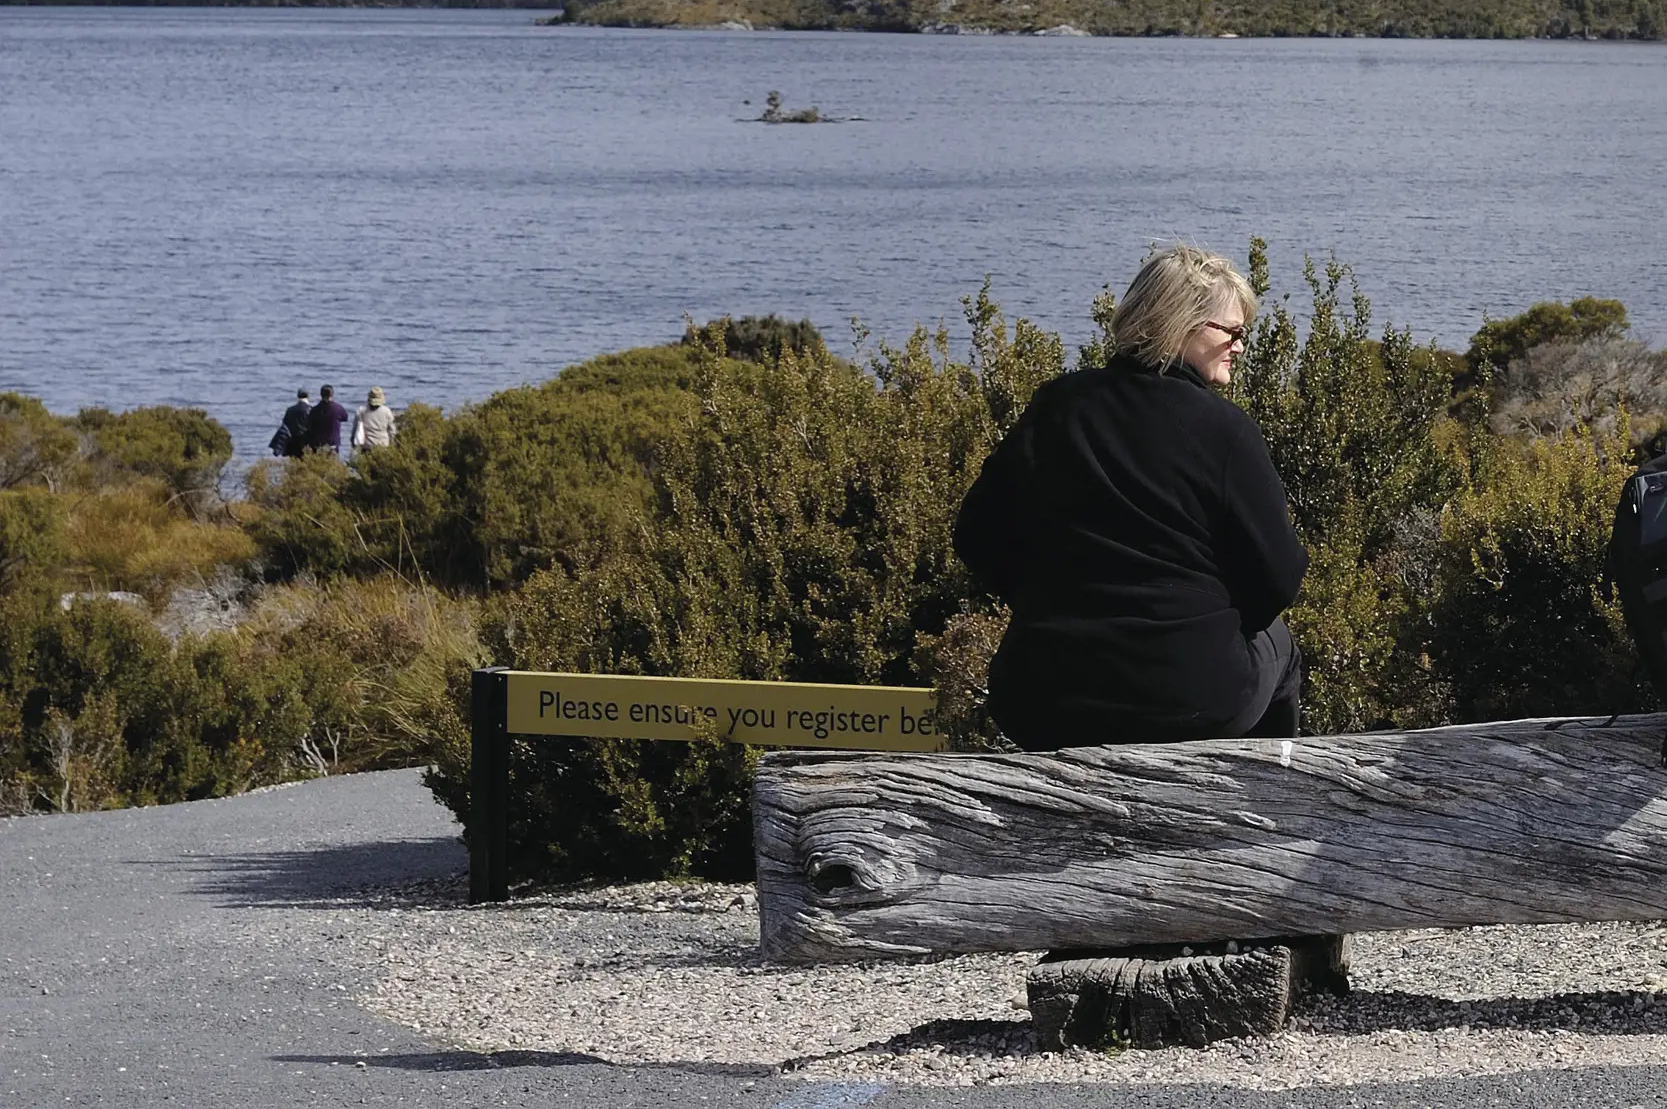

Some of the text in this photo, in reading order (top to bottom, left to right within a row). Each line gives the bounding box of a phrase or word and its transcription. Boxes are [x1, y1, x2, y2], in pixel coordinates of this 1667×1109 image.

[539, 690, 939, 739] Please ensure you register be
